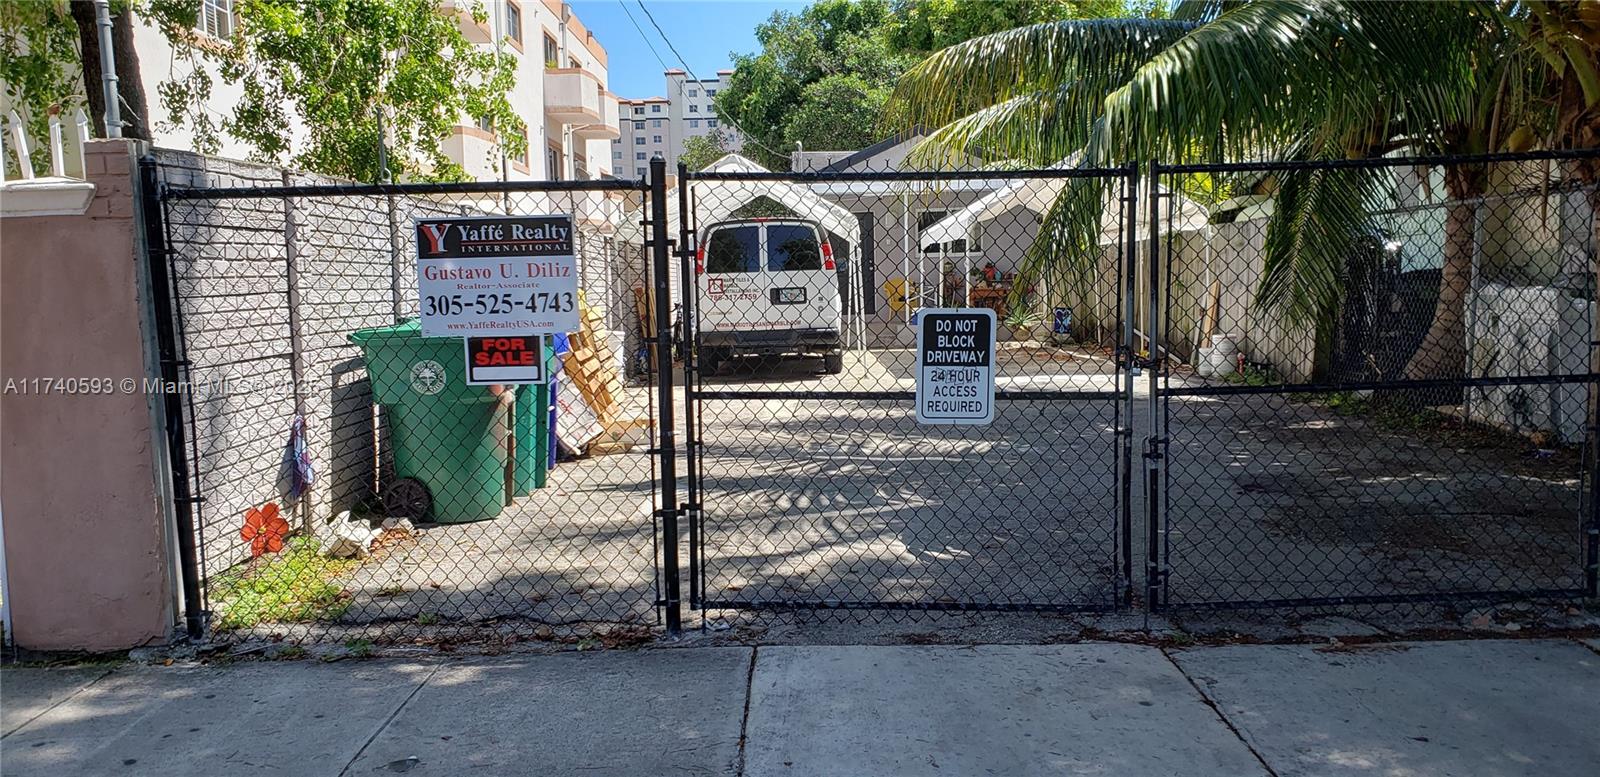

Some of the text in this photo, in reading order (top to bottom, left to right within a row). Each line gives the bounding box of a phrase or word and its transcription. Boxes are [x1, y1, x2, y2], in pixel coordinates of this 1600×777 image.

[458, 223, 569, 242] Yaffé Realty
[461, 244, 570, 253] INTERNATIONAL
[424, 263, 571, 281] Gustavo U. Diliz
[457, 282, 540, 290] Realtor-Associate
[425, 292, 574, 316] 305-525-4743
[447, 320, 555, 330] www.YaffeRealtyUSA.com
[936, 320, 978, 332] DO NOT
[482, 338, 526, 351] FOR
[937, 335, 975, 347] BLOCK
[475, 351, 535, 365] SALE
[927, 350, 985, 363] DRIVEWAY
[930, 370, 980, 382] 24 HOUR
[933, 385, 977, 397] ACCESS
[927, 400, 983, 413] REQUIRED
